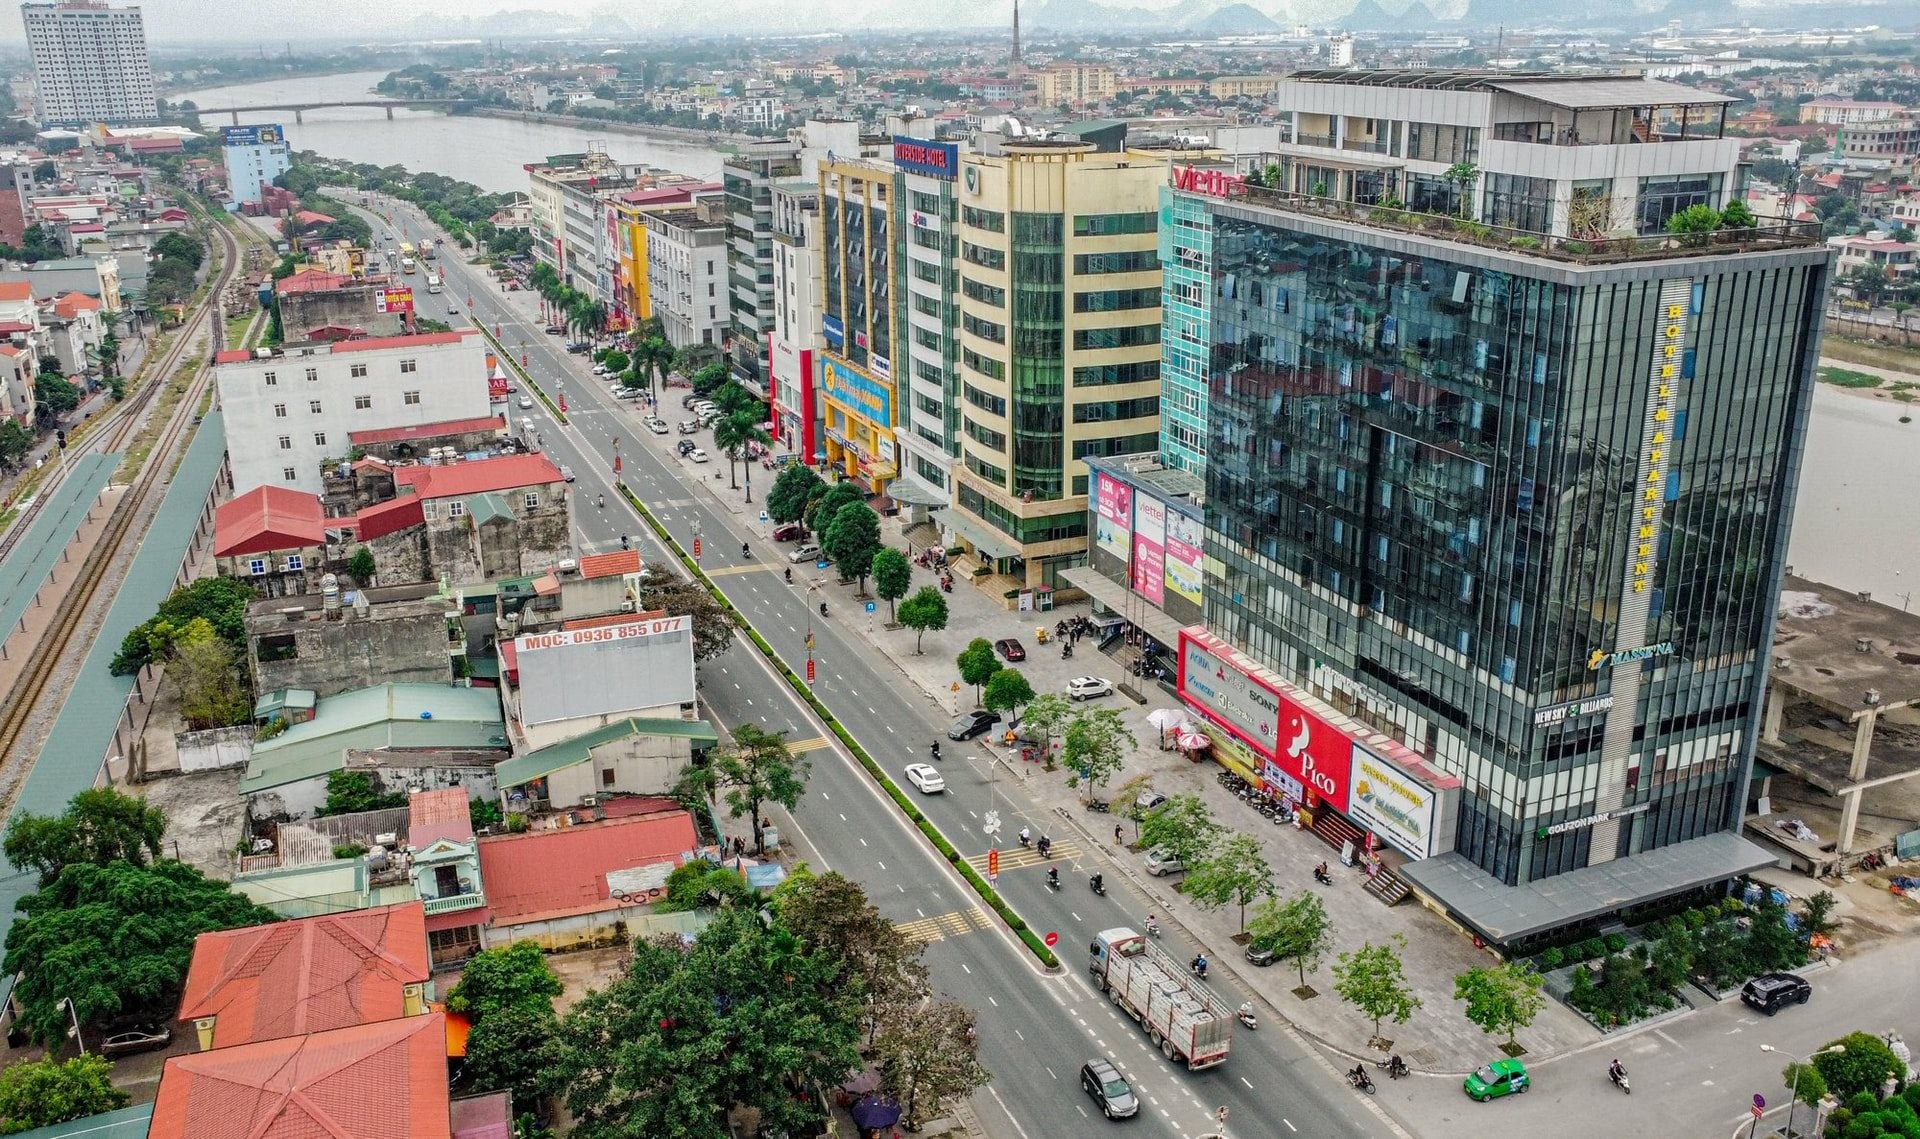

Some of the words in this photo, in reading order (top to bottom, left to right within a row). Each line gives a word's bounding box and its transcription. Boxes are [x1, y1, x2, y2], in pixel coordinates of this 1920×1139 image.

[895, 142, 926, 165] RIVERSIDE
[926, 148, 947, 169] HOTEL
[1101, 478, 1114, 495] 15K
[1633, 431, 1665, 593] APARTMENT
[573, 628, 613, 644] 0936
[618, 623, 648, 639] 855
[652, 618, 682, 634] 077
[1249, 690, 1279, 715] SONY
[1535, 709, 1552, 725] NEW
[1552, 706, 1568, 721] SKY
[1579, 696, 1614, 715] BILLIARDS
[1548, 817, 1588, 836] GOLFZON
[1586, 812, 1610, 828] PARK
